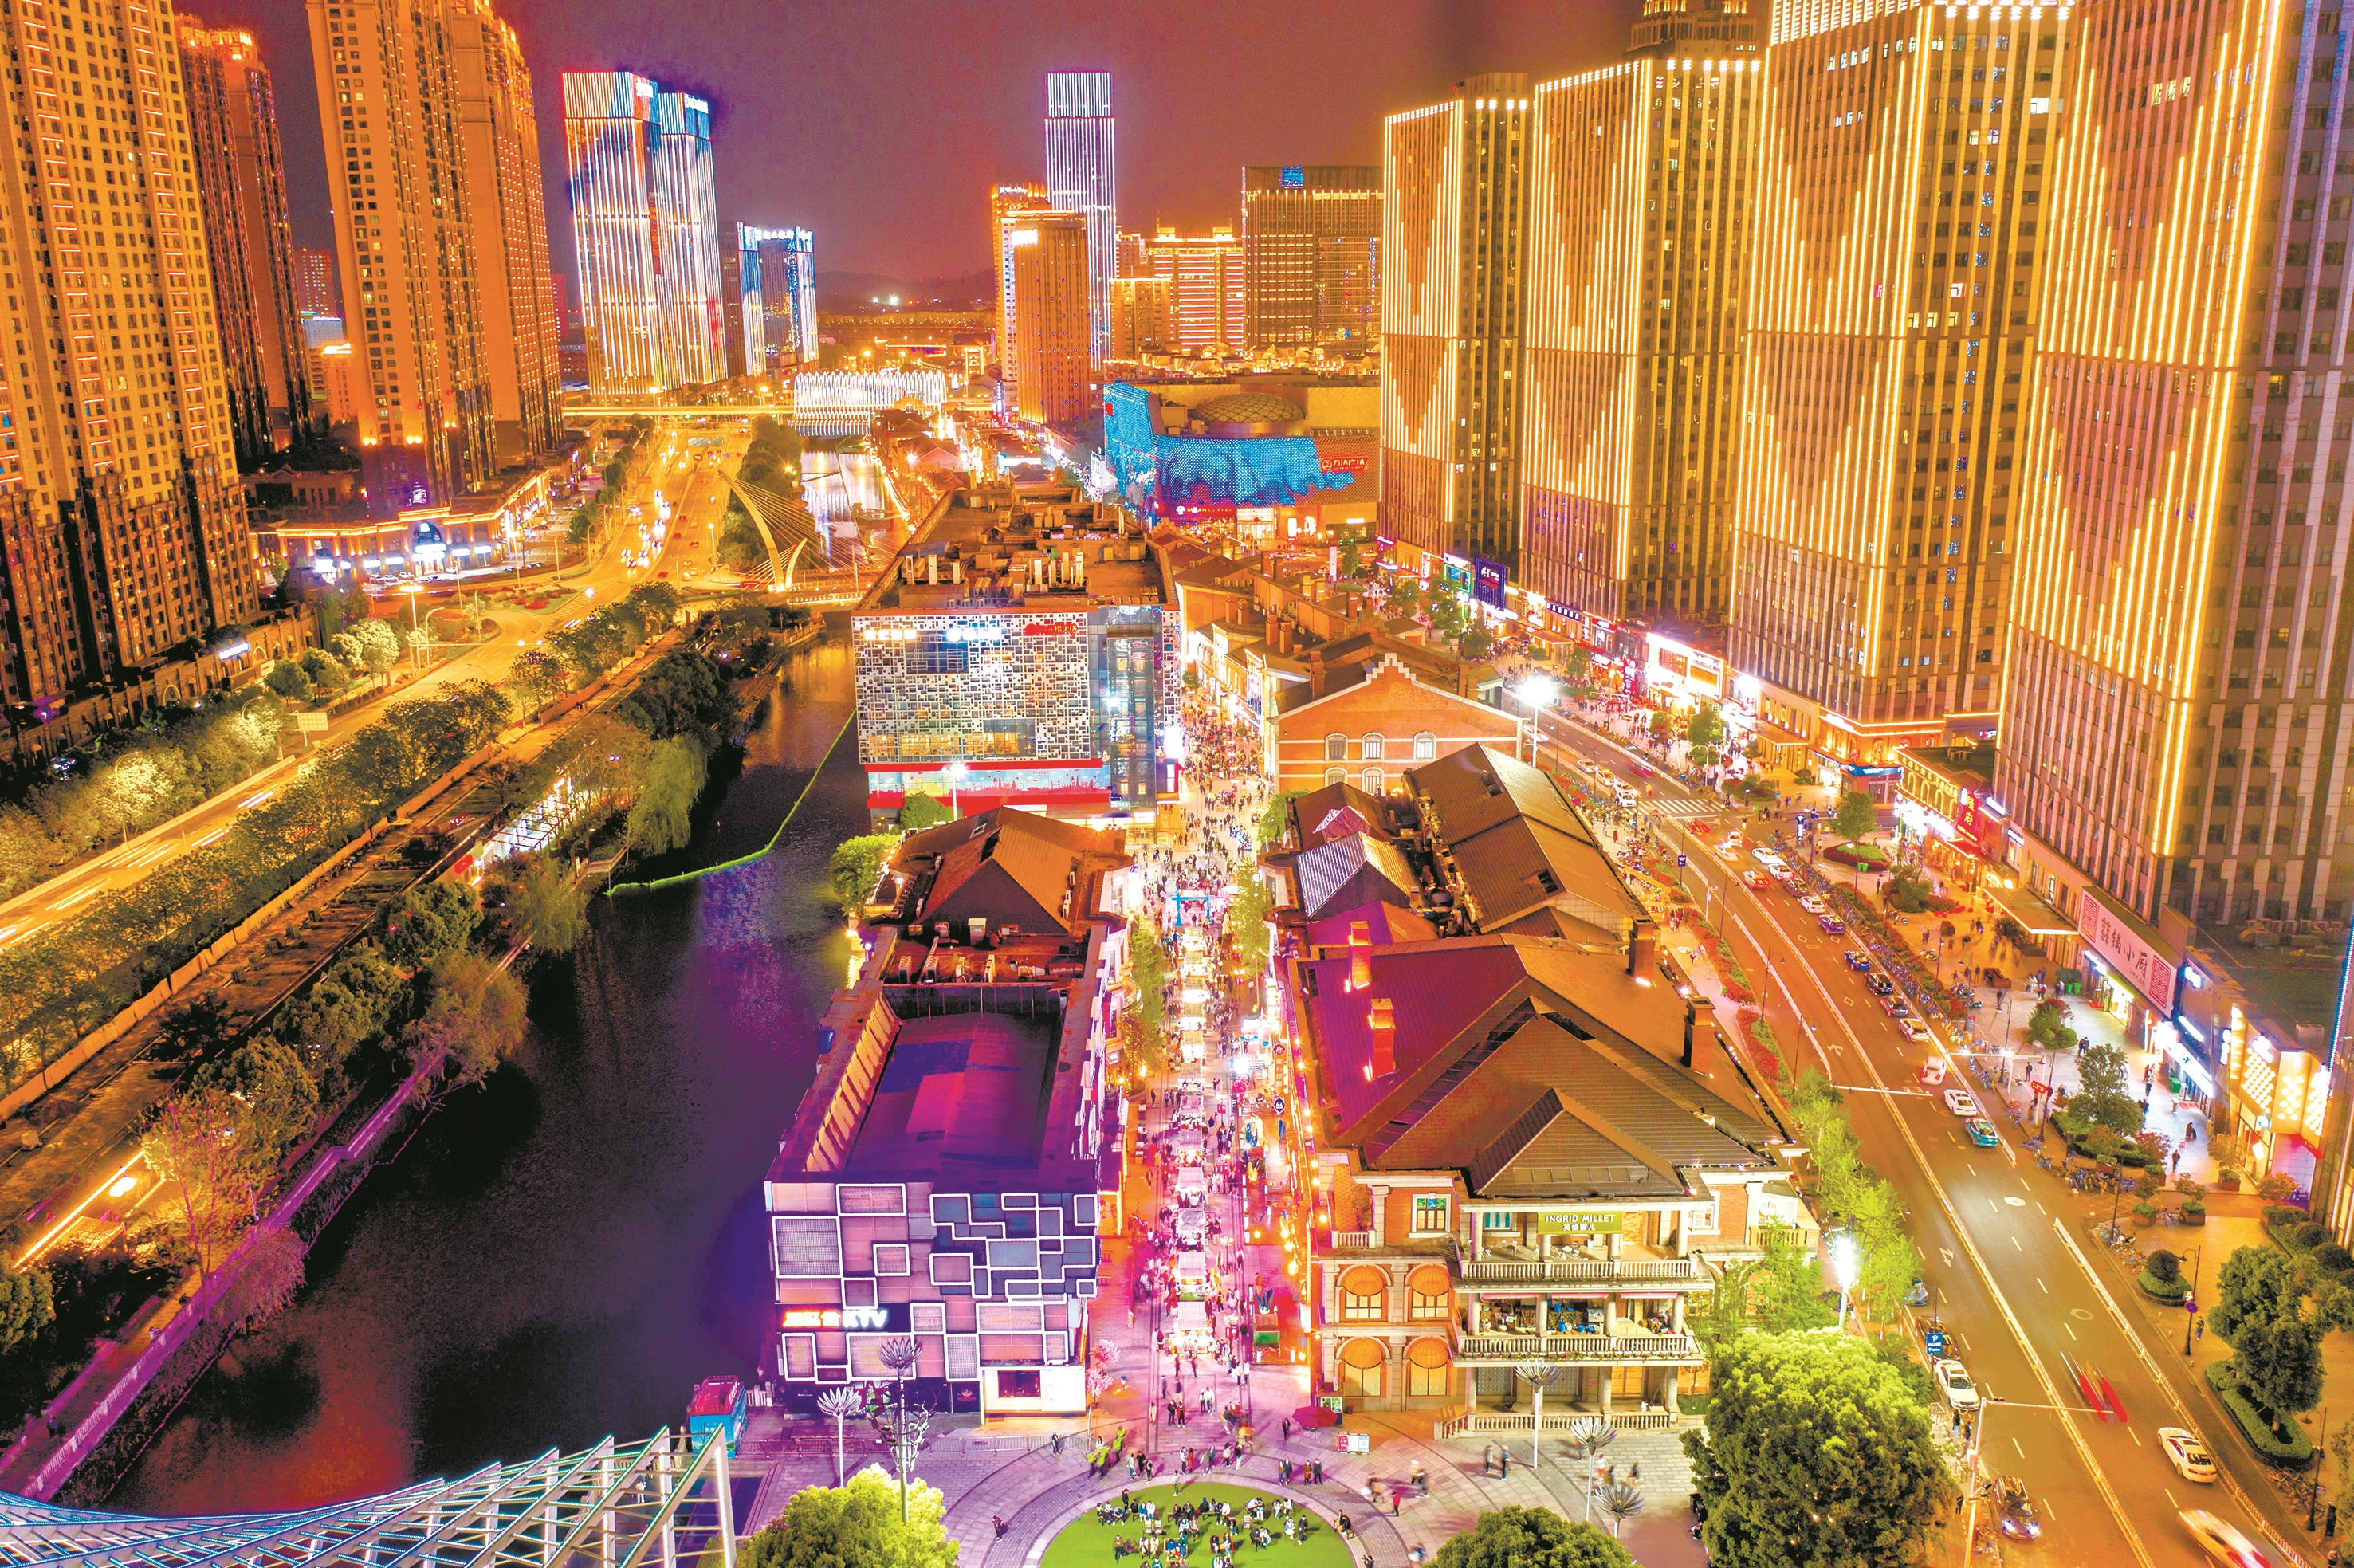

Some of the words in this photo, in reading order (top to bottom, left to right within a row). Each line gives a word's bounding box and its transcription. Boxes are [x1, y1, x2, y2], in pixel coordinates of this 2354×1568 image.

[1546, 1214, 1578, 1223] INGRID
[1582, 1213, 1616, 1222] MILLET
[1562, 1223, 1596, 1232] 英格蜜儿
[843, 1310, 887, 1328] KTV
